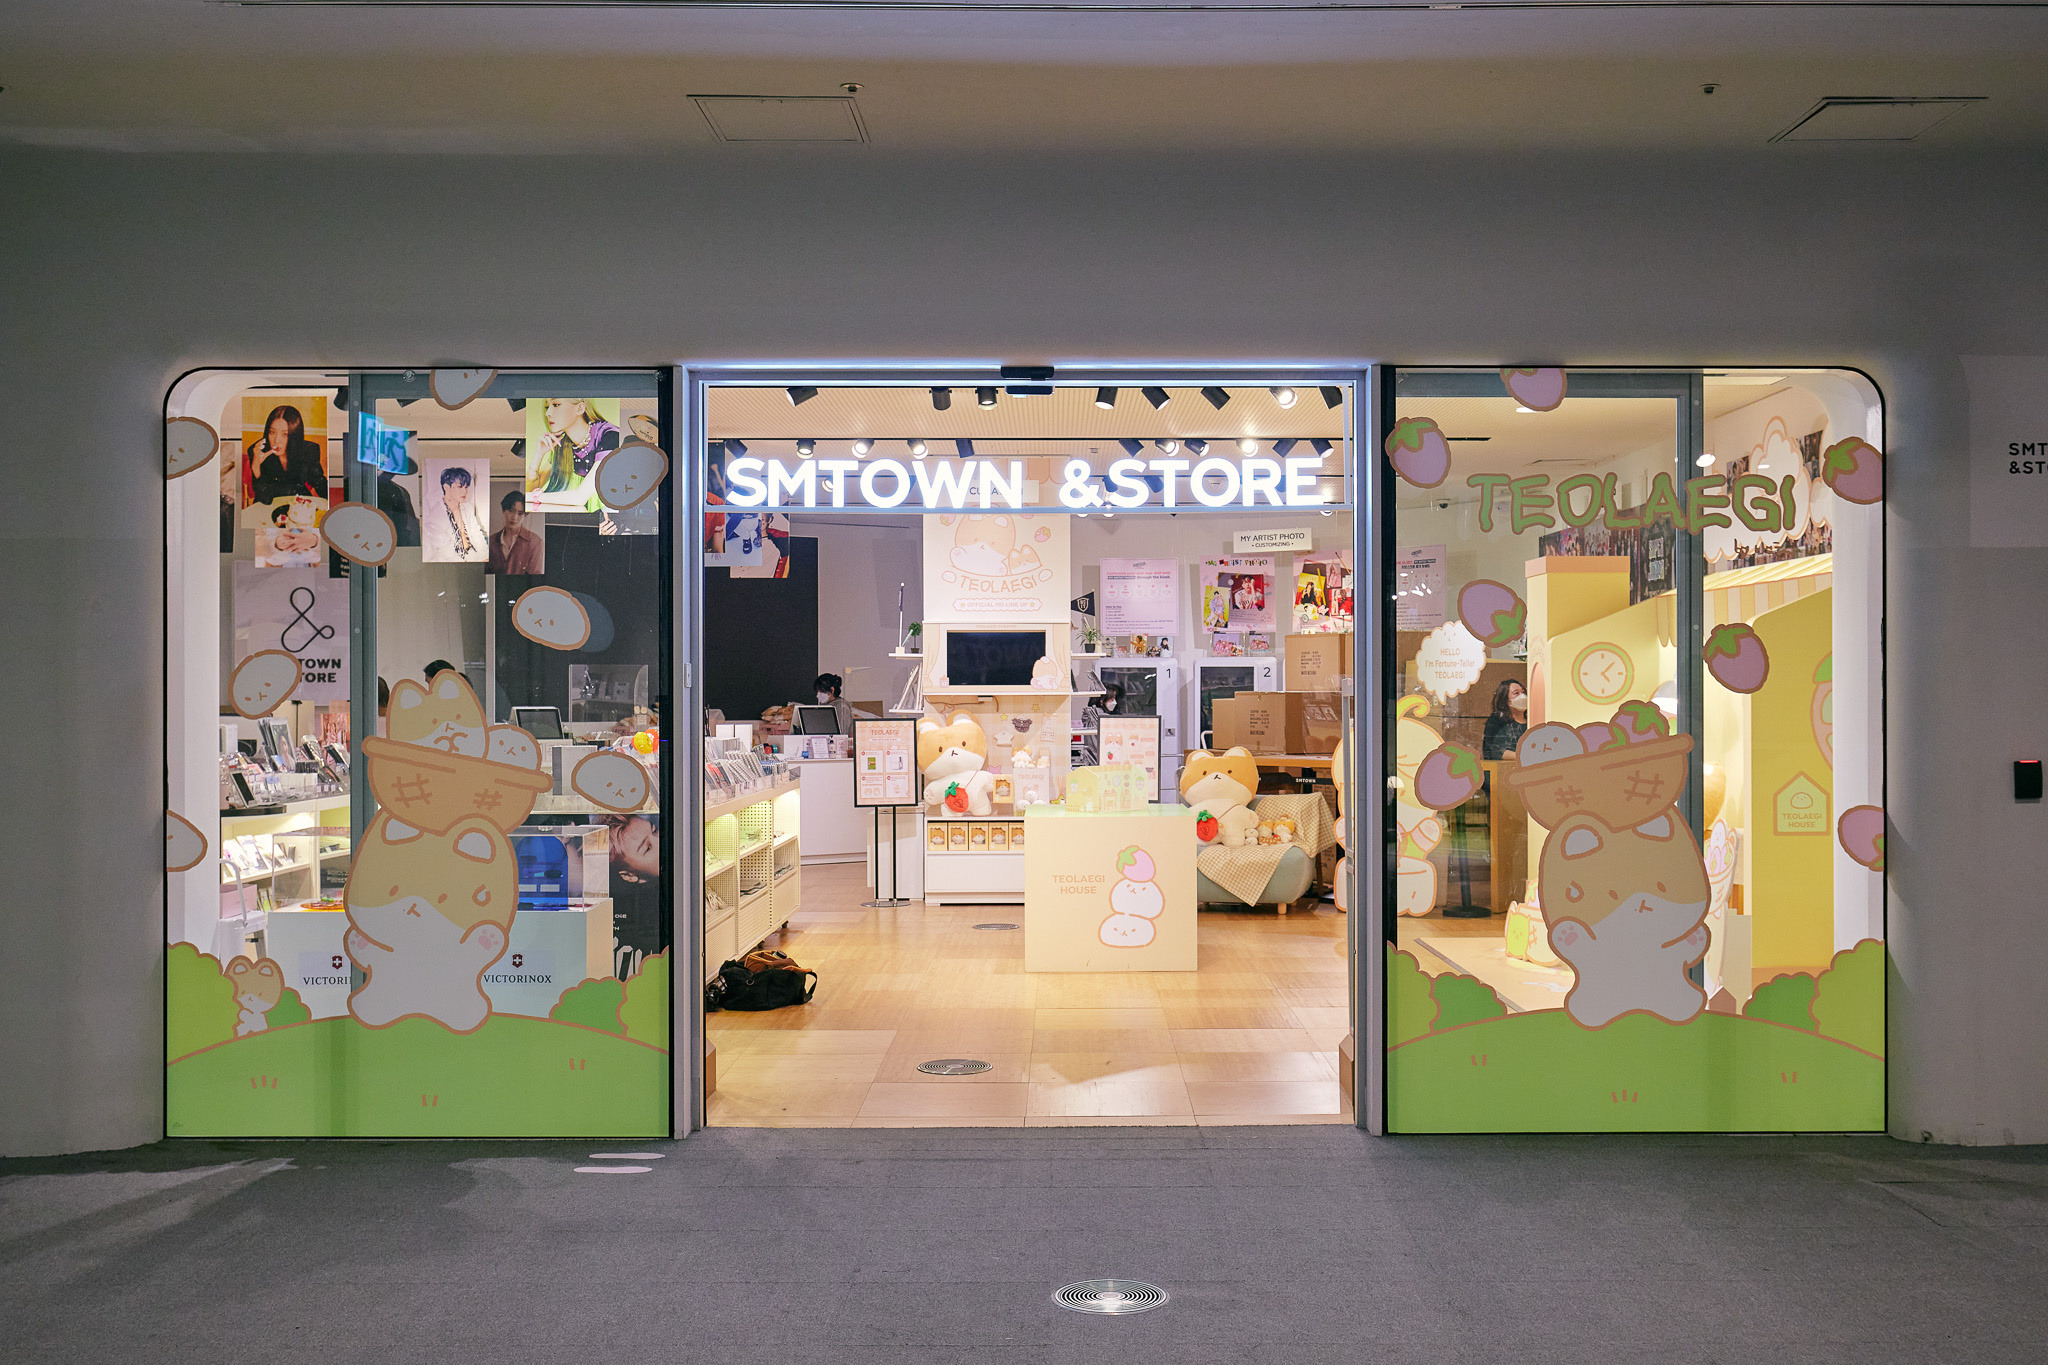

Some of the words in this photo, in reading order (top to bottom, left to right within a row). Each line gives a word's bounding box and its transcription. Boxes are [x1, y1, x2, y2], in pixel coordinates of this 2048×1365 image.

[2009, 460, 2048, 474] &ST
[725, 457, 1023, 509] SMTOWN
[1059, 457, 1326, 509] &STORE
[1467, 471, 1796, 535] TEOLAEGI
[1253, 533, 1278, 542] ARTIST
[1279, 532, 1305, 540] PHOTO
[961, 575, 1038, 594] TEOLAEGI
[1440, 648, 1461, 656] HELLO
[298, 658, 342, 669] TOWN
[1166, 668, 1171, 679] 1
[1263, 667, 1271, 678] 2
[1435, 671, 1466, 679] TEOLAEGI
[1782, 812, 1823, 820] TEOLAEGI
[1052, 874, 1105, 883] TEOLAEGI
[1060, 885, 1097, 894] HOUSE
[303, 976, 351, 985] VICTORI
[483, 974, 552, 984] VICTORINOX
